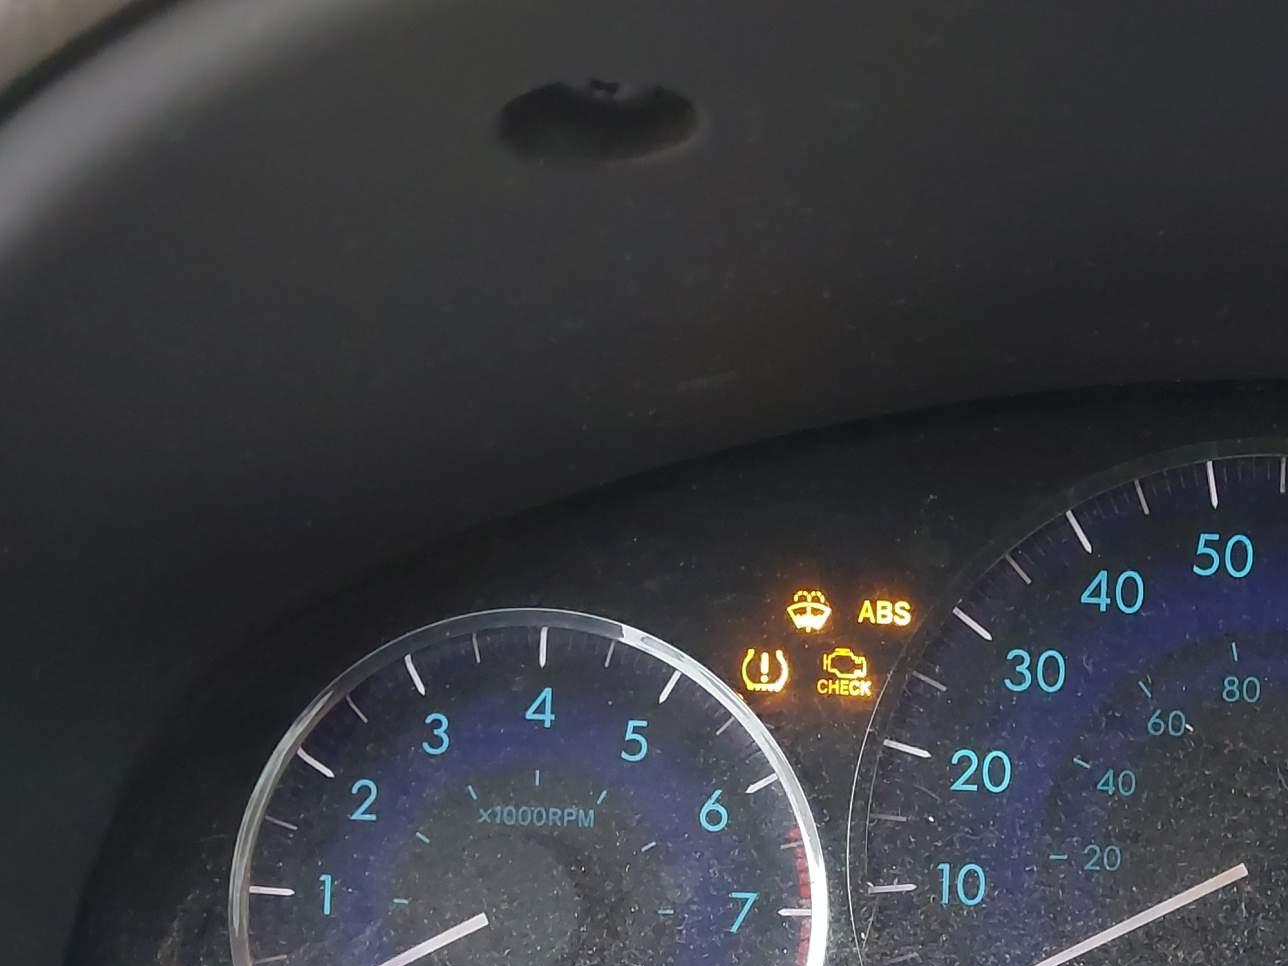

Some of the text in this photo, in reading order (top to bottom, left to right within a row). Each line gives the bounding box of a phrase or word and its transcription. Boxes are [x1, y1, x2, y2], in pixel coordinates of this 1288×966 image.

[1193, 533, 1254, 578] 50
[856, 599, 913, 627] ABS
[1080, 570, 1145, 614] 40
[816, 678, 873, 697] CHECK
[1004, 648, 1066, 693] 30
[1222, 675, 1260, 704] 80
[525, 687, 555, 728] 4
[1146, 709, 1186, 737] 60
[422, 712, 450, 755] 3
[621, 719, 648, 762] 5
[951, 748, 1012, 793] 20
[1096, 768, 1136, 796] 40
[350, 778, 378, 821] 2
[699, 789, 729, 832] 6
[1083, 844, 1121, 871] 20
[320, 874, 332, 915] 1
[937, 863, 986, 906] 10
[730, 891, 758, 933] 7
